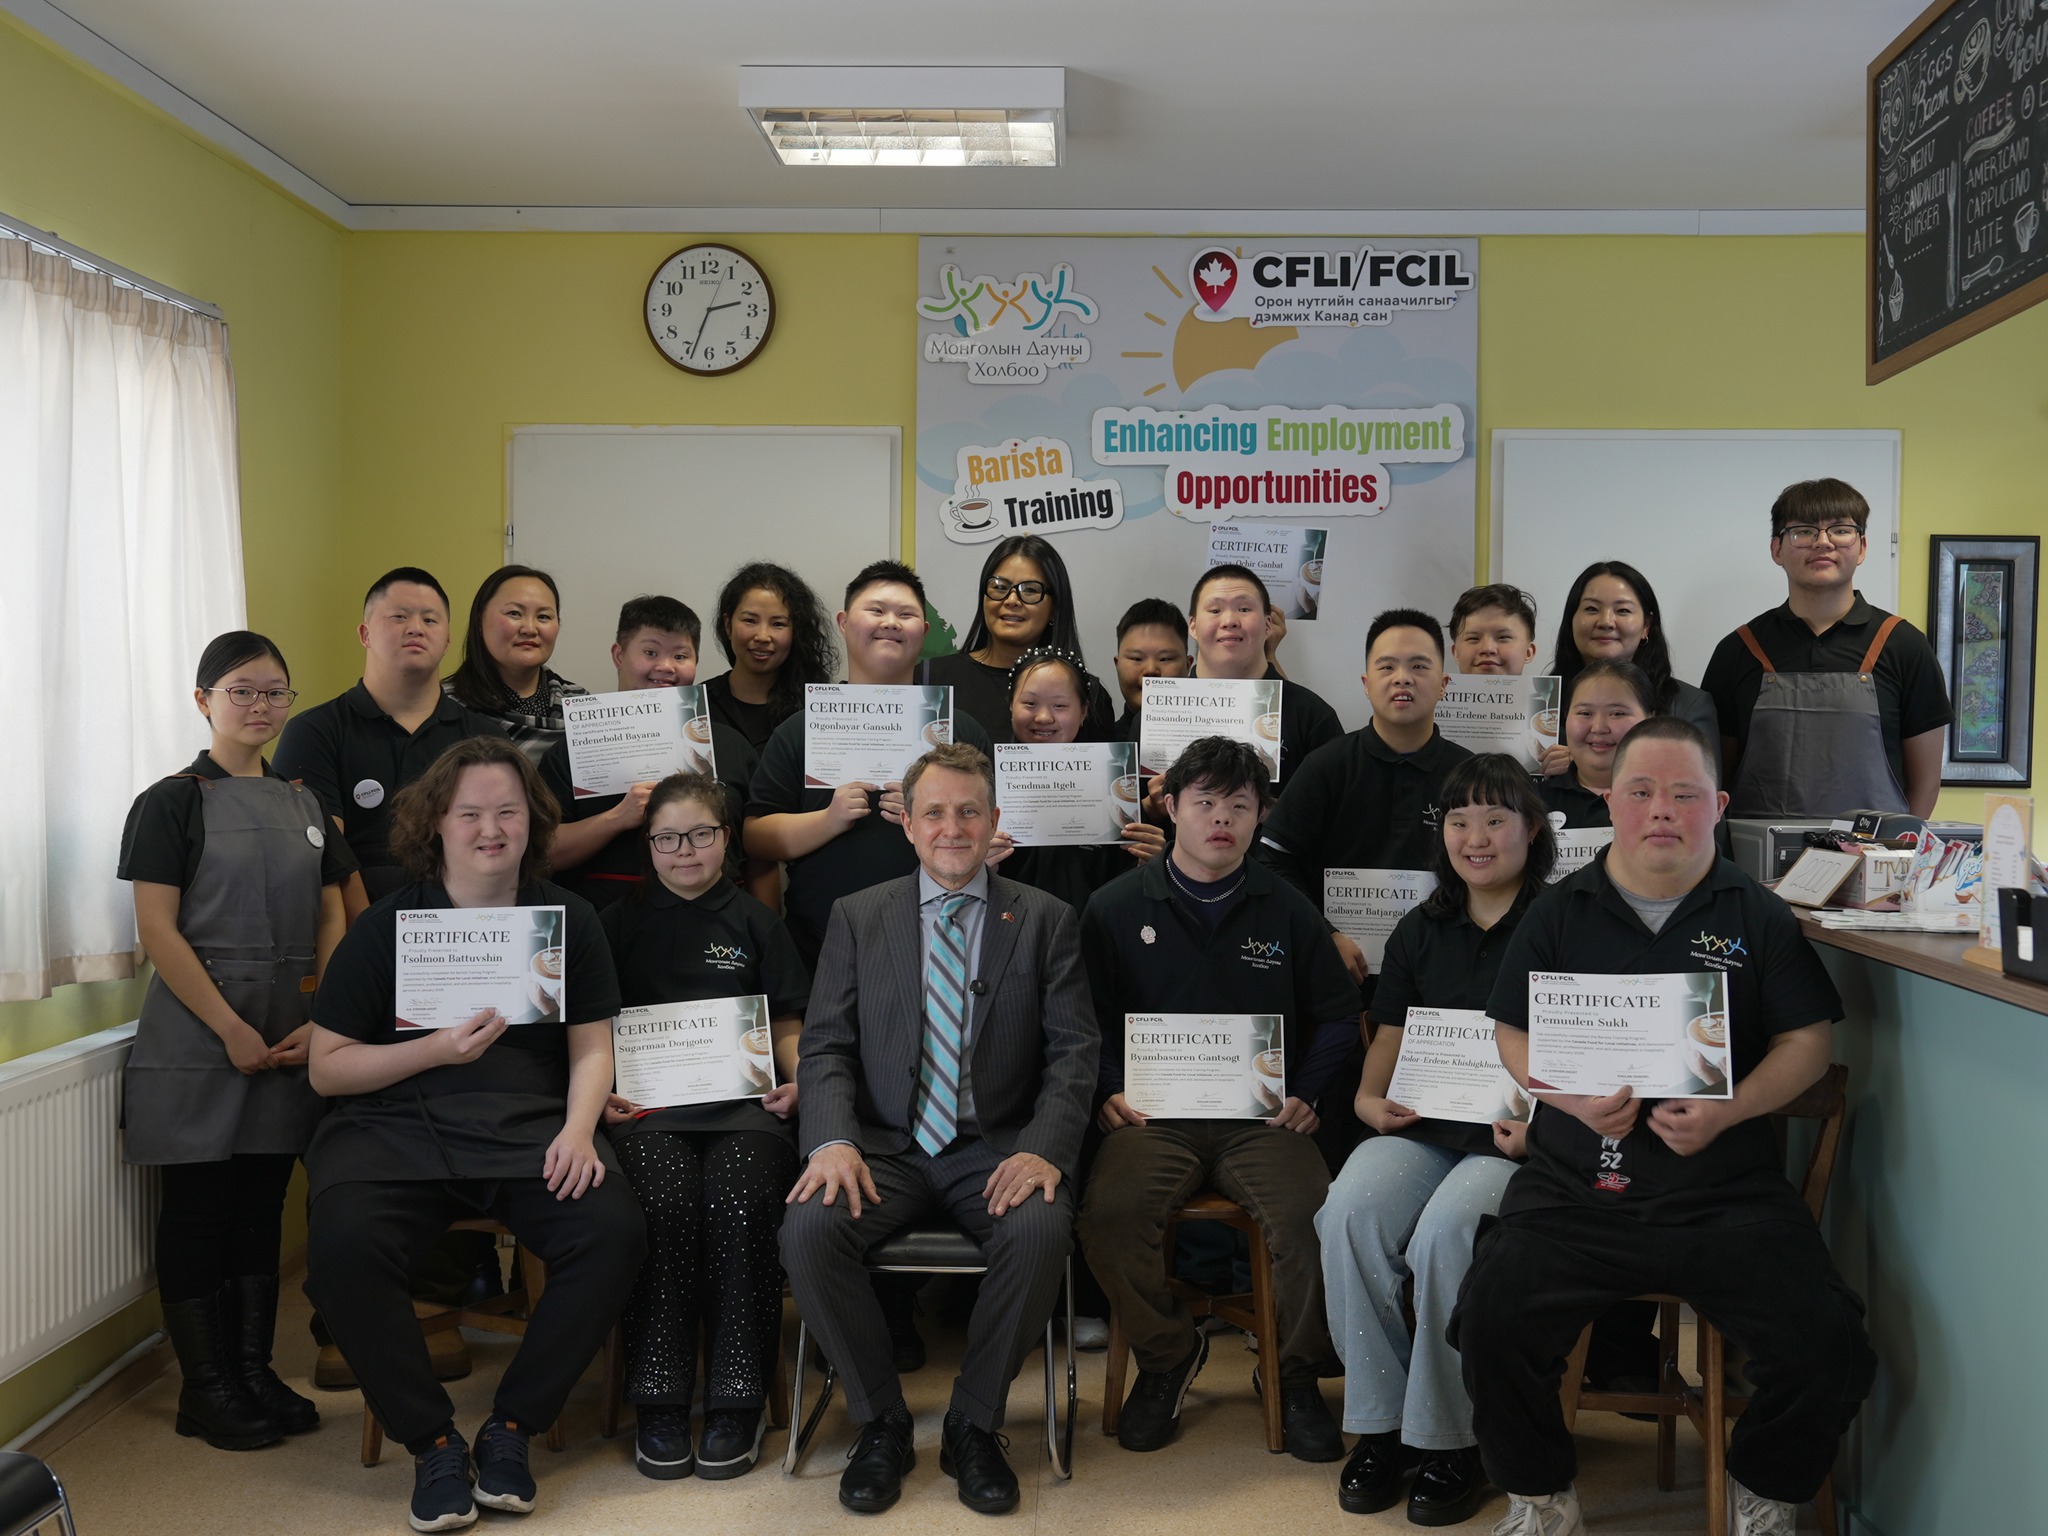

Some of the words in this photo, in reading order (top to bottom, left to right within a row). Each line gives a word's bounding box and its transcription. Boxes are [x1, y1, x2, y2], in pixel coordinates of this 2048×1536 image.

[1966, 92, 2013, 142] COFFEE
[1910, 139, 1935, 177] MENU
[1966, 137, 2030, 192] AMERICANO
[1904, 167, 1945, 217] SANDWICH
[1967, 168, 2030, 223] CAPPUCINO
[1905, 204, 1940, 244] BURGER
[1968, 216, 2003, 259] LATTE
[681, 265, 696, 280] 11
[700, 260, 720, 275] 12
[728, 265, 735, 280] 1
[1252, 250, 1470, 291] CFLI/FCIL
[665, 281, 684, 296] 10
[741, 281, 752, 296] 2
[661, 303, 672, 317] 9
[1254, 295, 1293, 310] Орон
[1297, 295, 1355, 310] нутгийн
[1358, 296, 1453, 309] санаачилгыг
[746, 303, 759, 318] 3
[1254, 312, 1310, 324] дэмжих
[1315, 311, 1359, 324] Канад
[1363, 312, 1388, 322] сан
[666, 324, 678, 339] 8
[741, 325, 752, 340] 4
[682, 340, 694, 355] 7
[703, 346, 715, 361] 6
[725, 341, 737, 355] 5
[931, 341, 1021, 356] Монголын
[1026, 341, 1083, 360] Дауны
[975, 362, 1039, 378] Холбоо
[1103, 416, 1258, 455] Enhancing
[1266, 415, 1452, 456] Employment
[967, 444, 1064, 487] Barista
[1176, 469, 1378, 511] Opportunities
[1003, 486, 1115, 529] Training
[1211, 540, 1288, 554] CERTIFICATE
[1257, 560, 1283, 569] Ganbat
[1146, 694, 1236, 708] CERTIFICATE
[1440, 692, 1514, 704] RTIFICATE
[568, 702, 662, 722] CERTIFICATE
[810, 702, 904, 714] CERTIFICATE
[1435, 710, 1488, 719] nkh-Erdene
[1490, 712, 1526, 720] Batsukh
[581, 720, 622, 729] APPRECIATION
[809, 722, 860, 732] Otgonbayar
[862, 722, 902, 732] Gansukh
[1146, 714, 1192, 724] Baasandorj
[1194, 716, 1244, 725] Dagvasuren
[572, 733, 623, 747] Erdenebold
[626, 732, 661, 742] Bayaraa
[1000, 760, 1092, 772] CERTIFICATE
[1006, 782, 1050, 790] Tsendmaa
[1053, 781, 1076, 791] Itgelt
[1326, 886, 1418, 900] CERTIFICATE
[1326, 906, 1364, 915] Galbayar
[1366, 908, 1406, 918] Batjargal
[402, 930, 510, 944] CERTIFICATE
[401, 954, 445, 964] Tsolmon
[448, 954, 502, 962] Battuvshin
[1534, 992, 1660, 1008] CERTIFICATE
[618, 1017, 718, 1036] CERTIFICATE
[1534, 1015, 1594, 1027] Temuulen
[1598, 1018, 1628, 1028] Sukh
[618, 1043, 666, 1054] Sugarmaa
[668, 1038, 714, 1048] Dorjgotov
[1130, 1033, 1232, 1044] CERTIFICATE
[1130, 1053, 1195, 1062] Byambasuren
[1198, 1054, 1240, 1063] Gantsogt
[1400, 1055, 1450, 1065] Bolor-Erdene
